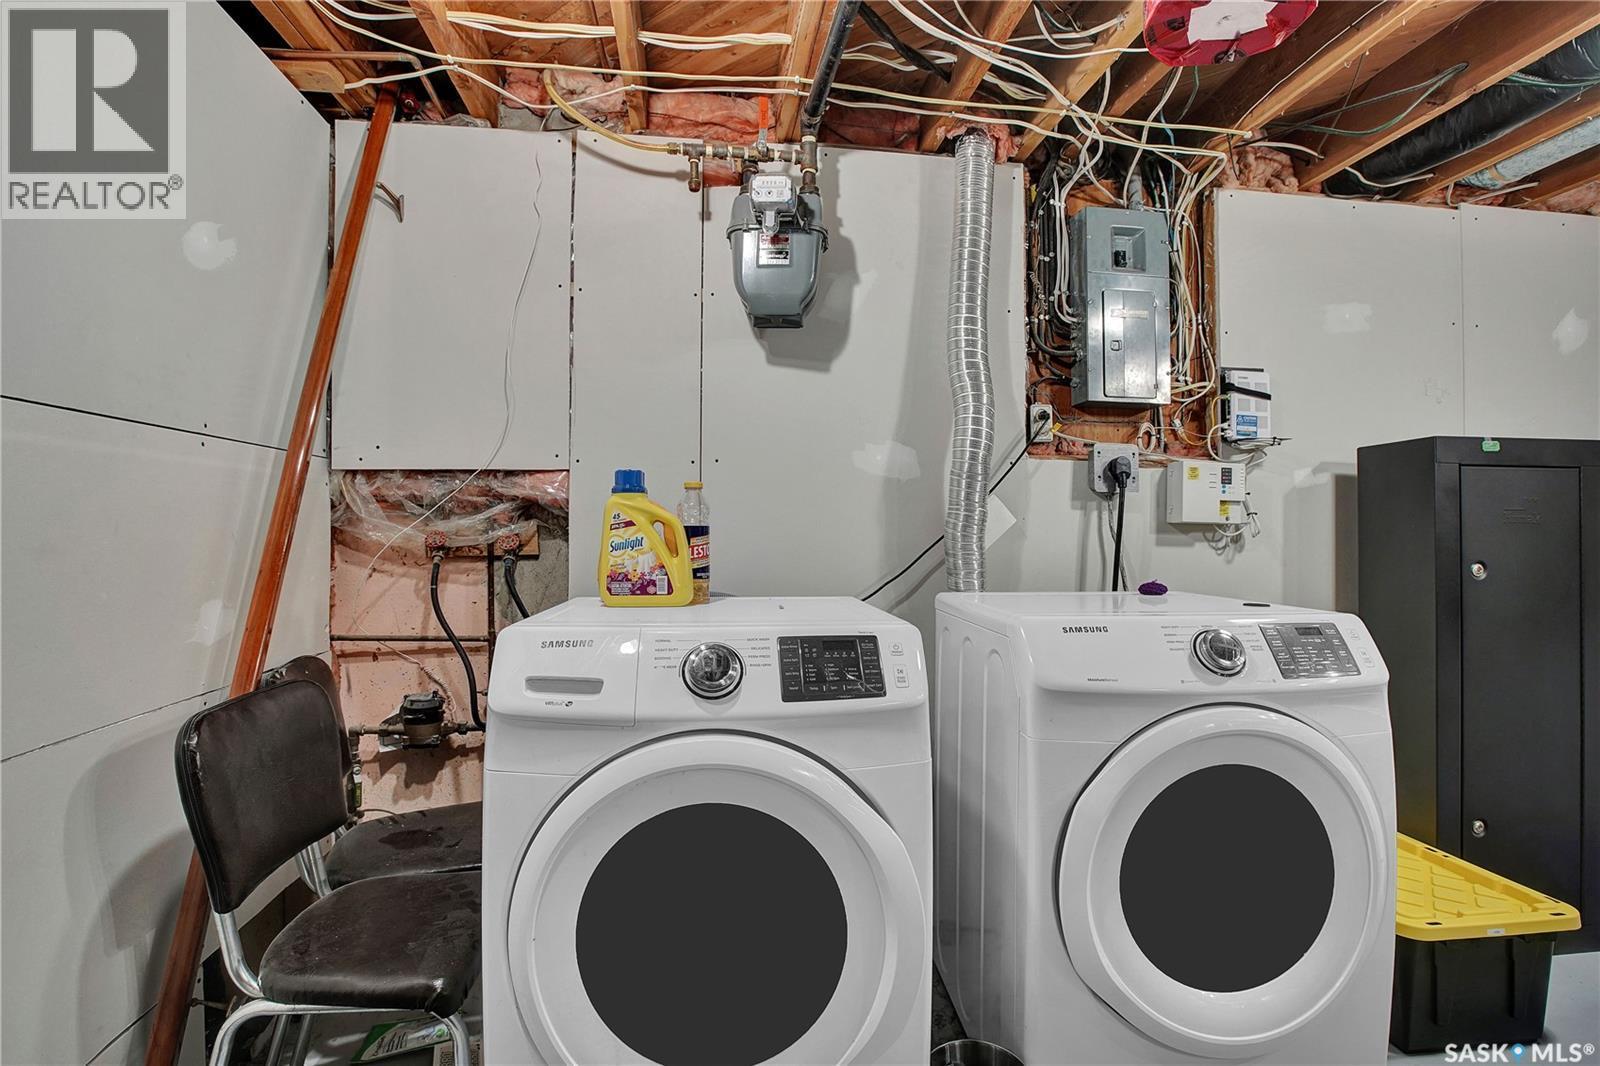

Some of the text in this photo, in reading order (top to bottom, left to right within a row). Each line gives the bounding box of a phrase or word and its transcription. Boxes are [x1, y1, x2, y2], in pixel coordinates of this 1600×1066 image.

[609, 536, 644, 553] Sunlight
[1062, 625, 1109, 634] SAMSUNG
[540, 639, 594, 649] SAMSUNG
